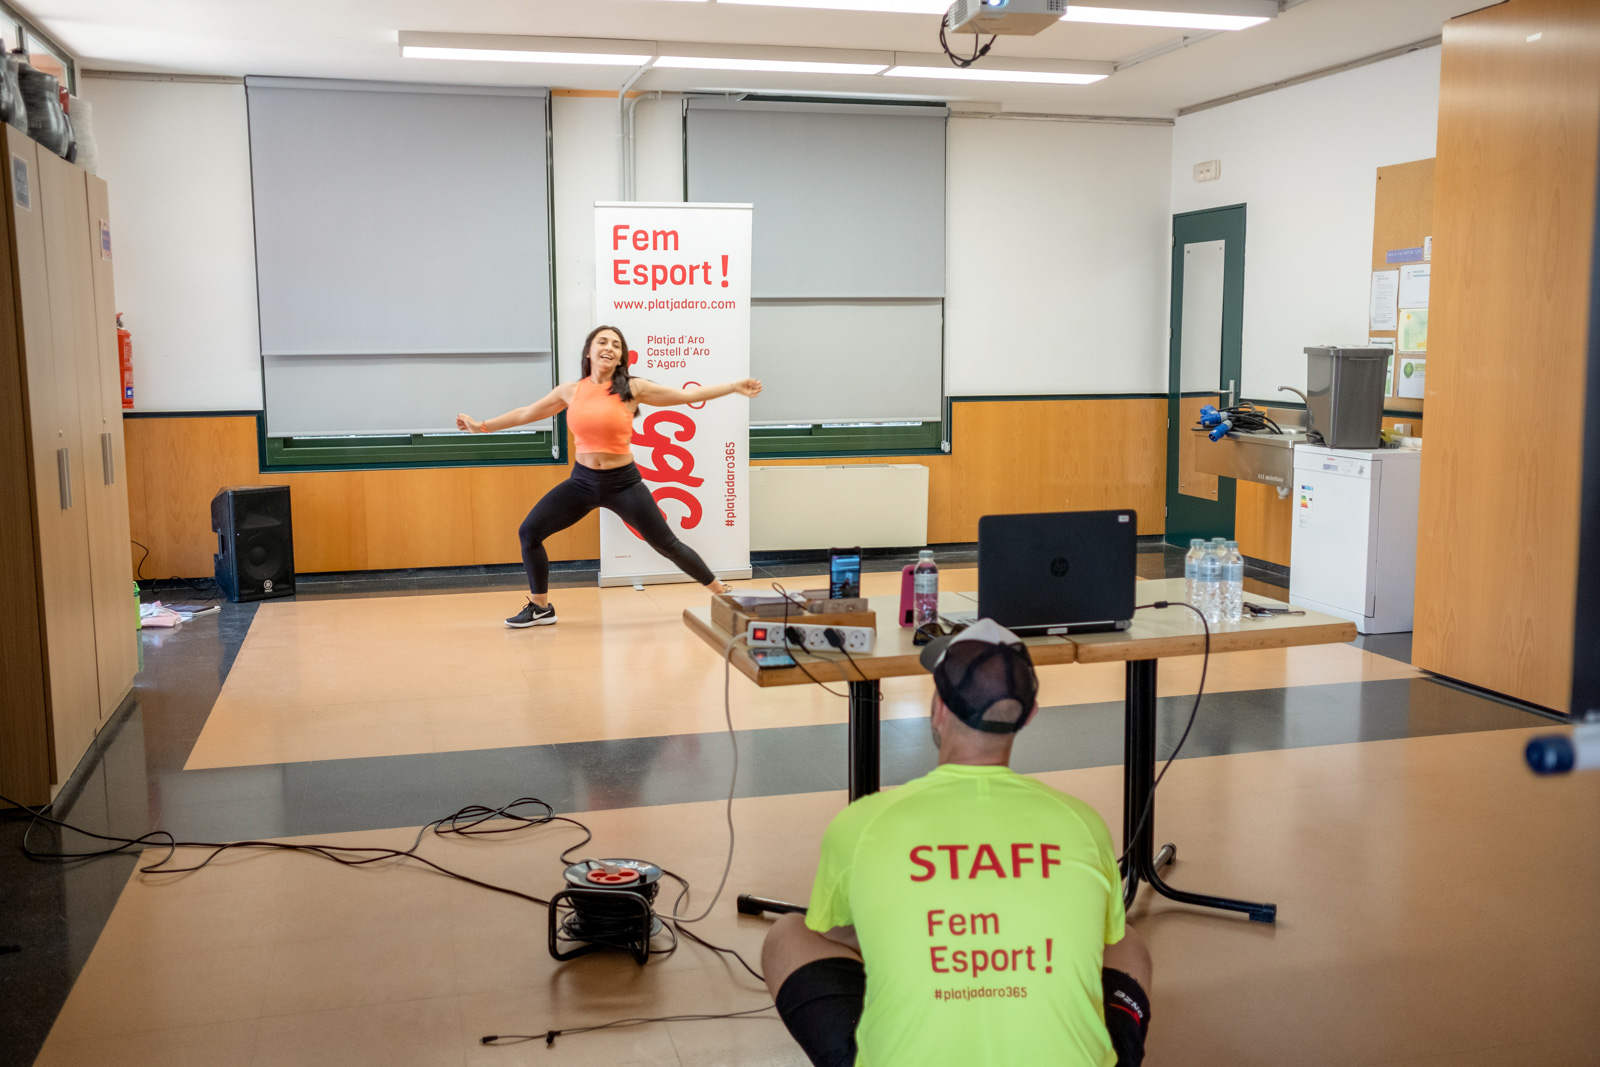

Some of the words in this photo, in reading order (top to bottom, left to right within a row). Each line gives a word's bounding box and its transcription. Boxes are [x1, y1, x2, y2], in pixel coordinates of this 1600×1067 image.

[613, 224, 679, 251] Fem
[613, 259, 712, 291] Esport
[614, 298, 736, 311] www.platjadaro.com
[647, 335, 676, 345] Platja
[647, 347, 681, 356] Castell
[725, 441, 737, 527] #platjadaro365
[909, 843, 1062, 882] STAFF
[927, 909, 1000, 937] Fem
[929, 945, 1036, 978] Esport
[934, 986, 1028, 1002] #platjadaro365
